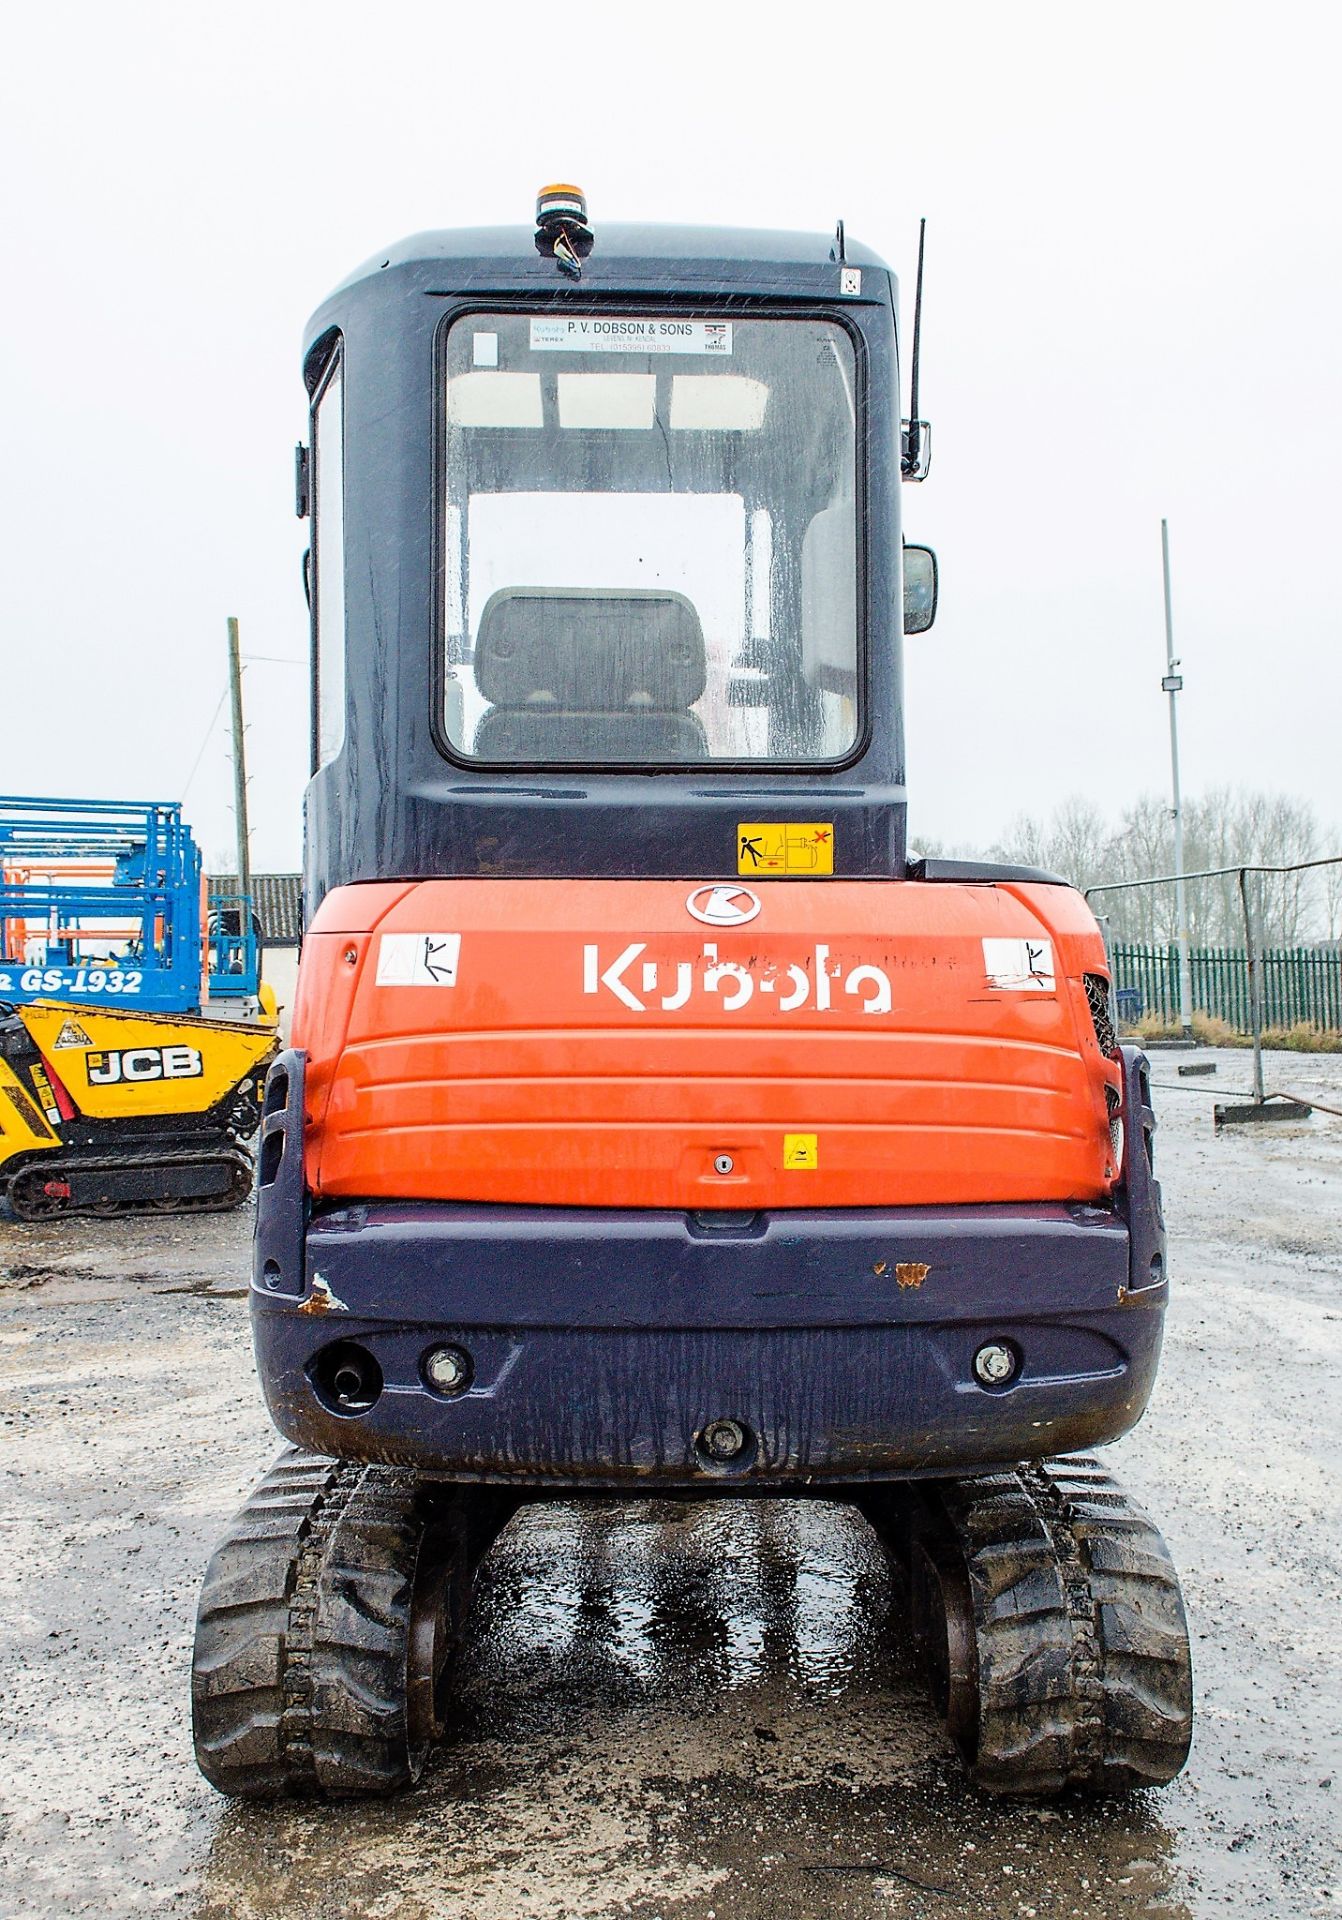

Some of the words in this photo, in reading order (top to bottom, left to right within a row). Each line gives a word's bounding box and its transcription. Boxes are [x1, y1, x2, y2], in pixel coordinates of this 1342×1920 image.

[567, 321, 577, 333] P.
[580, 321, 590, 333] V.
[593, 322, 645, 335] DOBSON
[648, 323, 656, 335] &
[659, 323, 693, 336] SONS
[20, 969, 143, 993] GS-1932
[88, 1046, 202, 1084] JCB
